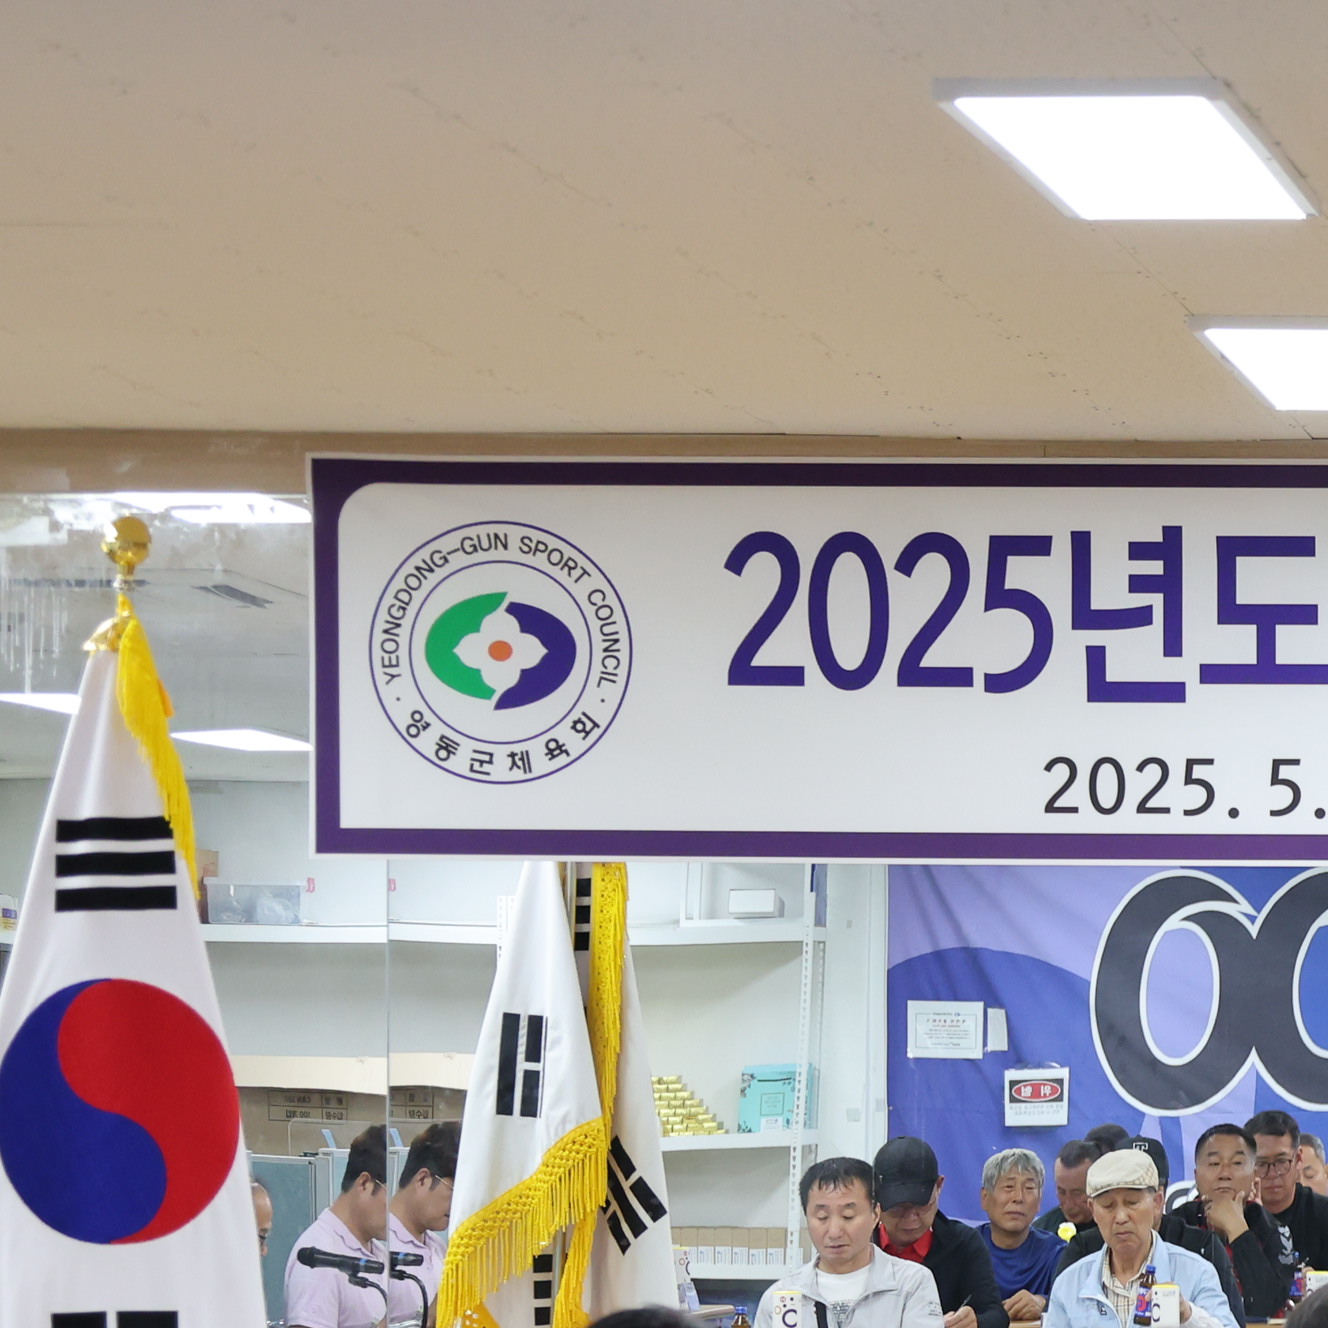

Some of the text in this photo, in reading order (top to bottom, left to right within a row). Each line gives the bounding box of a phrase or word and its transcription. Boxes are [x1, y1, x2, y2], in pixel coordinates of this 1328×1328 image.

[380, 532, 621, 688] YEONGDONG-GUN SPORT COUNCIL
[405, 710, 600, 776] 영동군체육회
[1043, 755, 1240, 820] 2025.
[1268, 756, 1327, 820] 5.
